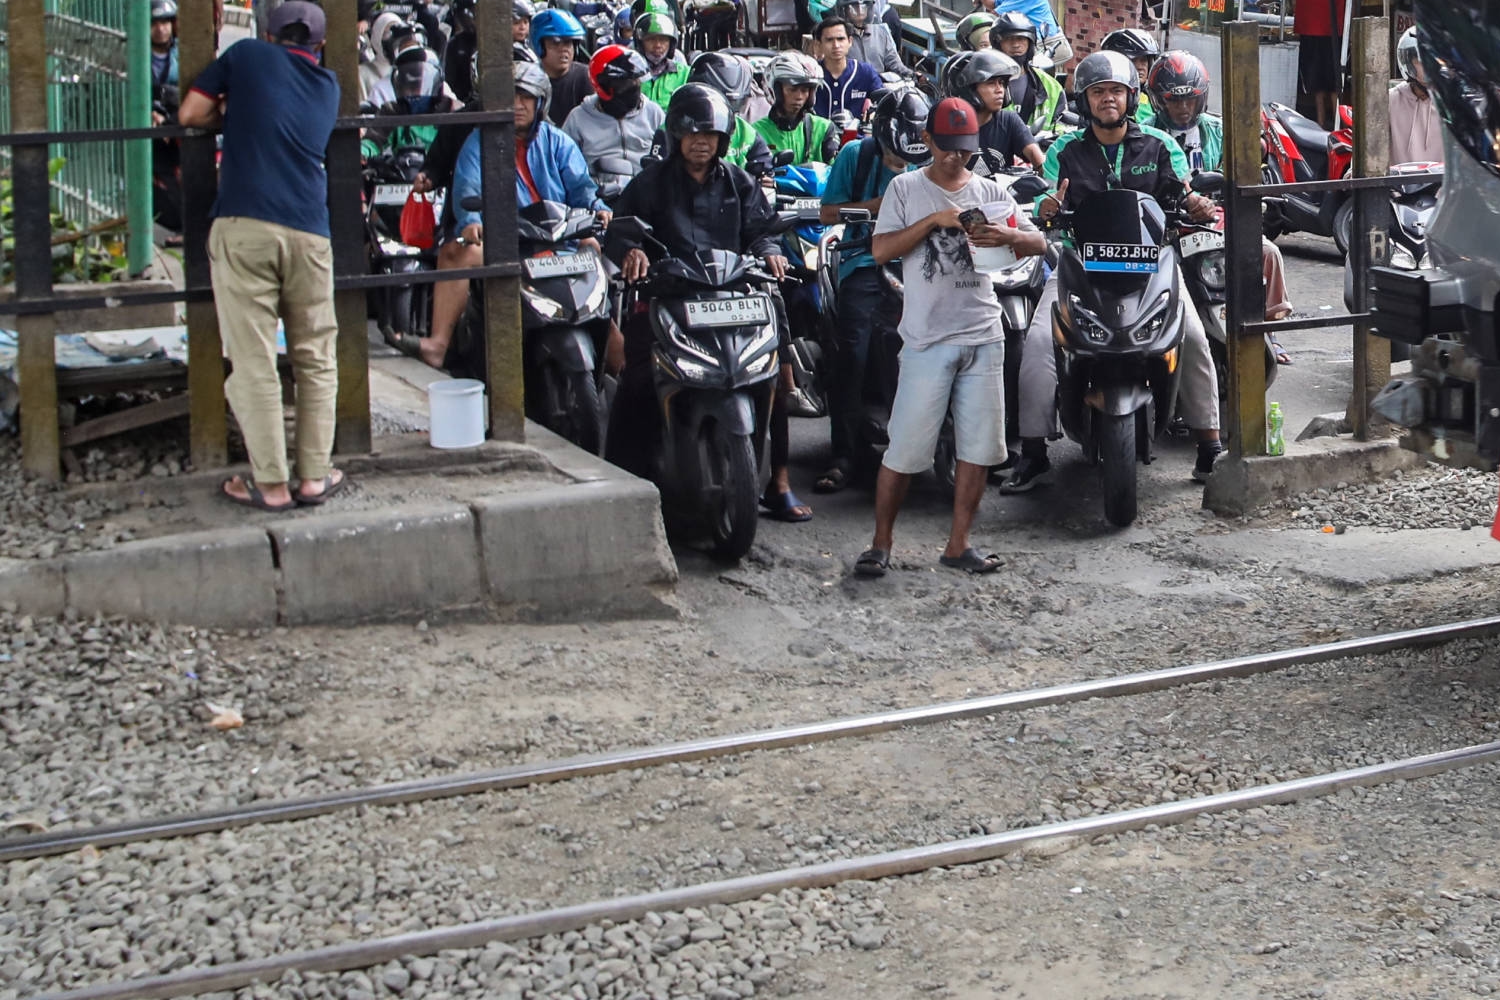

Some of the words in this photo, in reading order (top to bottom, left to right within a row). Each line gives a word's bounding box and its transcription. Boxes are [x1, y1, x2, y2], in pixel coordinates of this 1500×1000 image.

[1131, 162, 1157, 175] Grab
[1086, 245, 1094, 257] B
[1099, 246, 1129, 258] 5823
[1133, 246, 1158, 259] BWG
[689, 304, 696, 314] B
